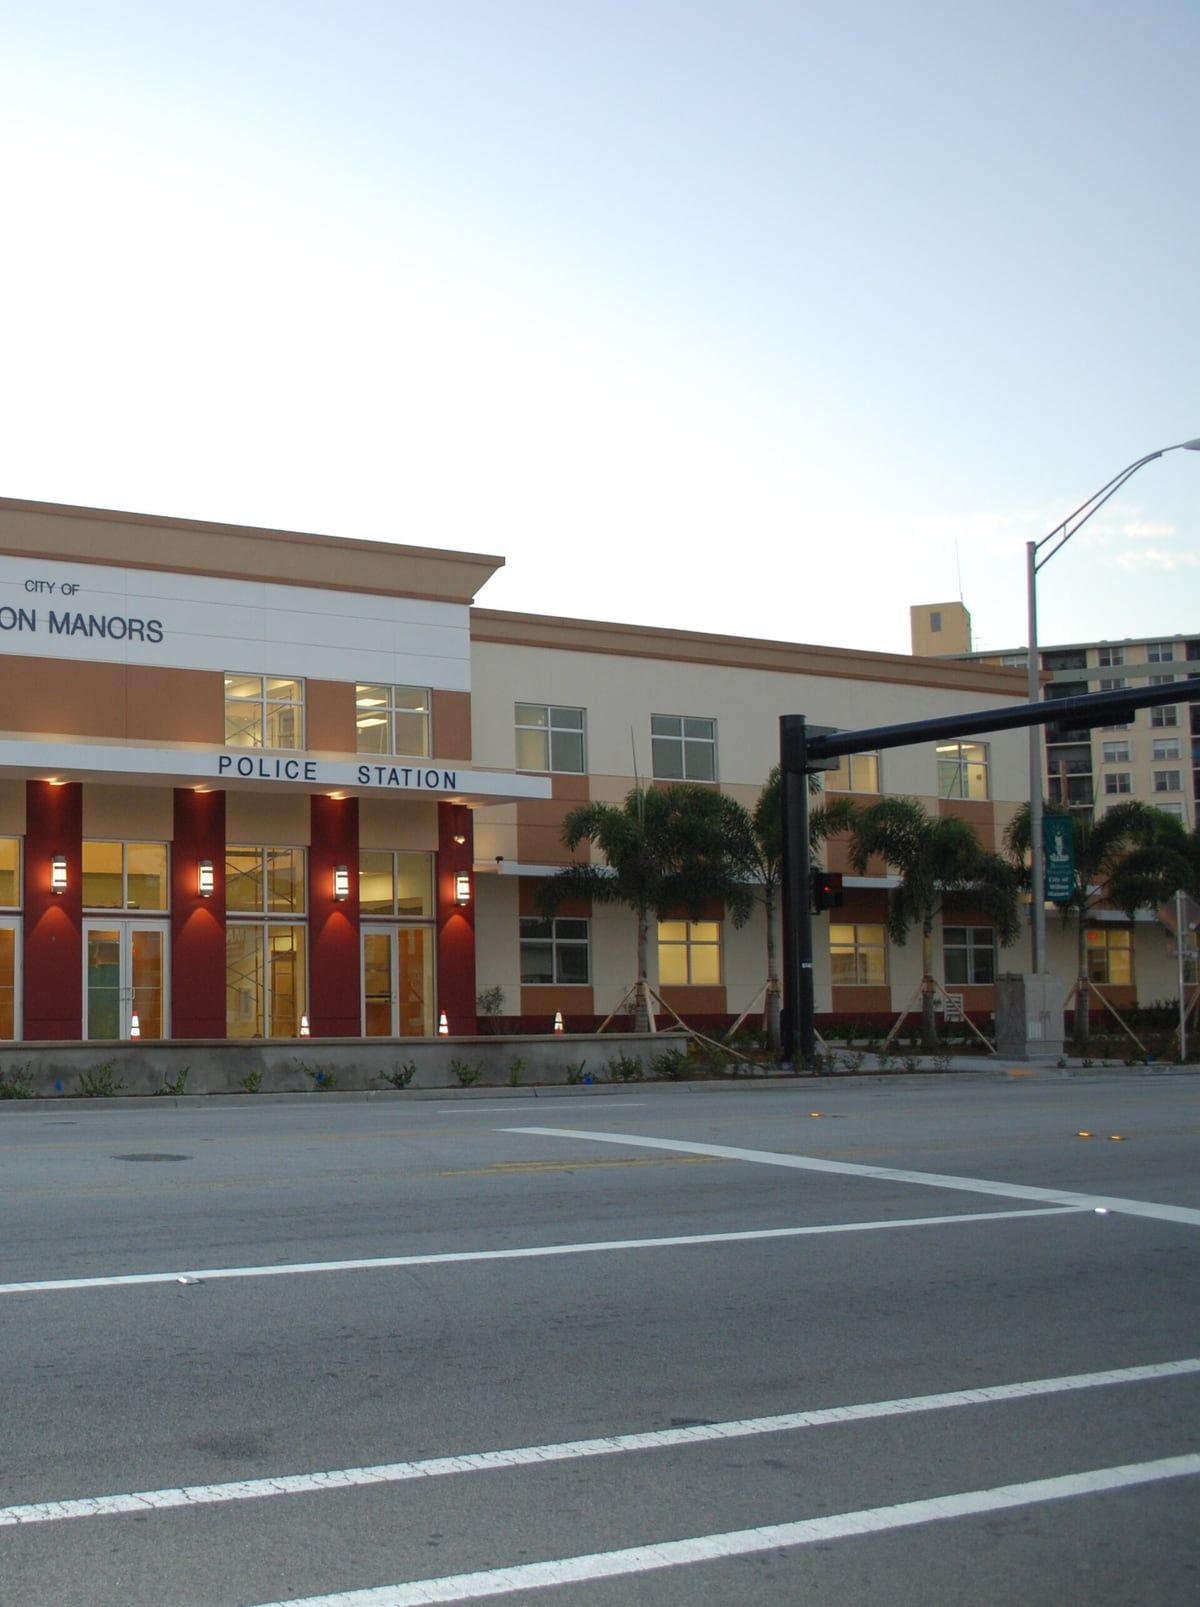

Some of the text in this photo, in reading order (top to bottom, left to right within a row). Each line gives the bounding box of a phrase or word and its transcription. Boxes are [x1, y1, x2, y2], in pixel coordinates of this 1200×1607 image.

[25, 580, 80, 596] CITY OF
[49, 610, 164, 643] MANORS
[218, 755, 456, 790] POLICE STATION
